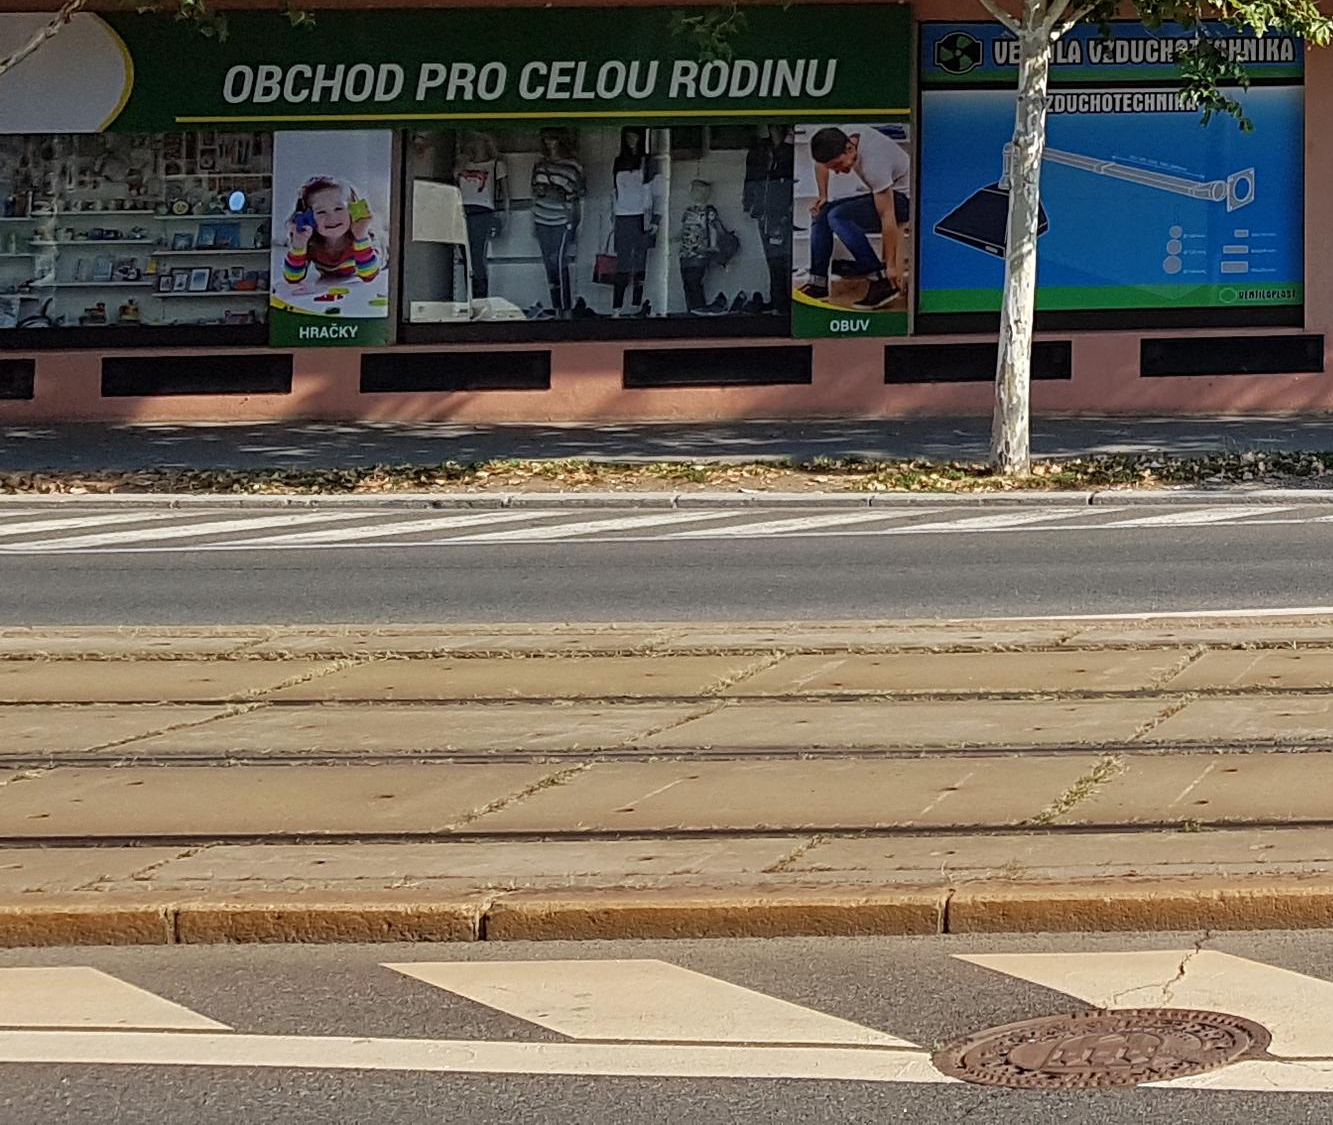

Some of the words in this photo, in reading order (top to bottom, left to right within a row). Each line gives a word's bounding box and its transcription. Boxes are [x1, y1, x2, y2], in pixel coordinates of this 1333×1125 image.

[994, 39, 1082, 64] VEILA
[1088, 37, 1295, 64] VZDUCHCHNIKA
[221, 63, 405, 104] OBCHOD
[415, 61, 509, 102] PRO
[519, 59, 660, 101] CELOU
[668, 58, 838, 100] RODINU
[1046, 93, 1197, 113] ZDUCHOTECHNIA
[299, 322, 358, 339] HRAČKY
[829, 318, 870, 332] OBUV
